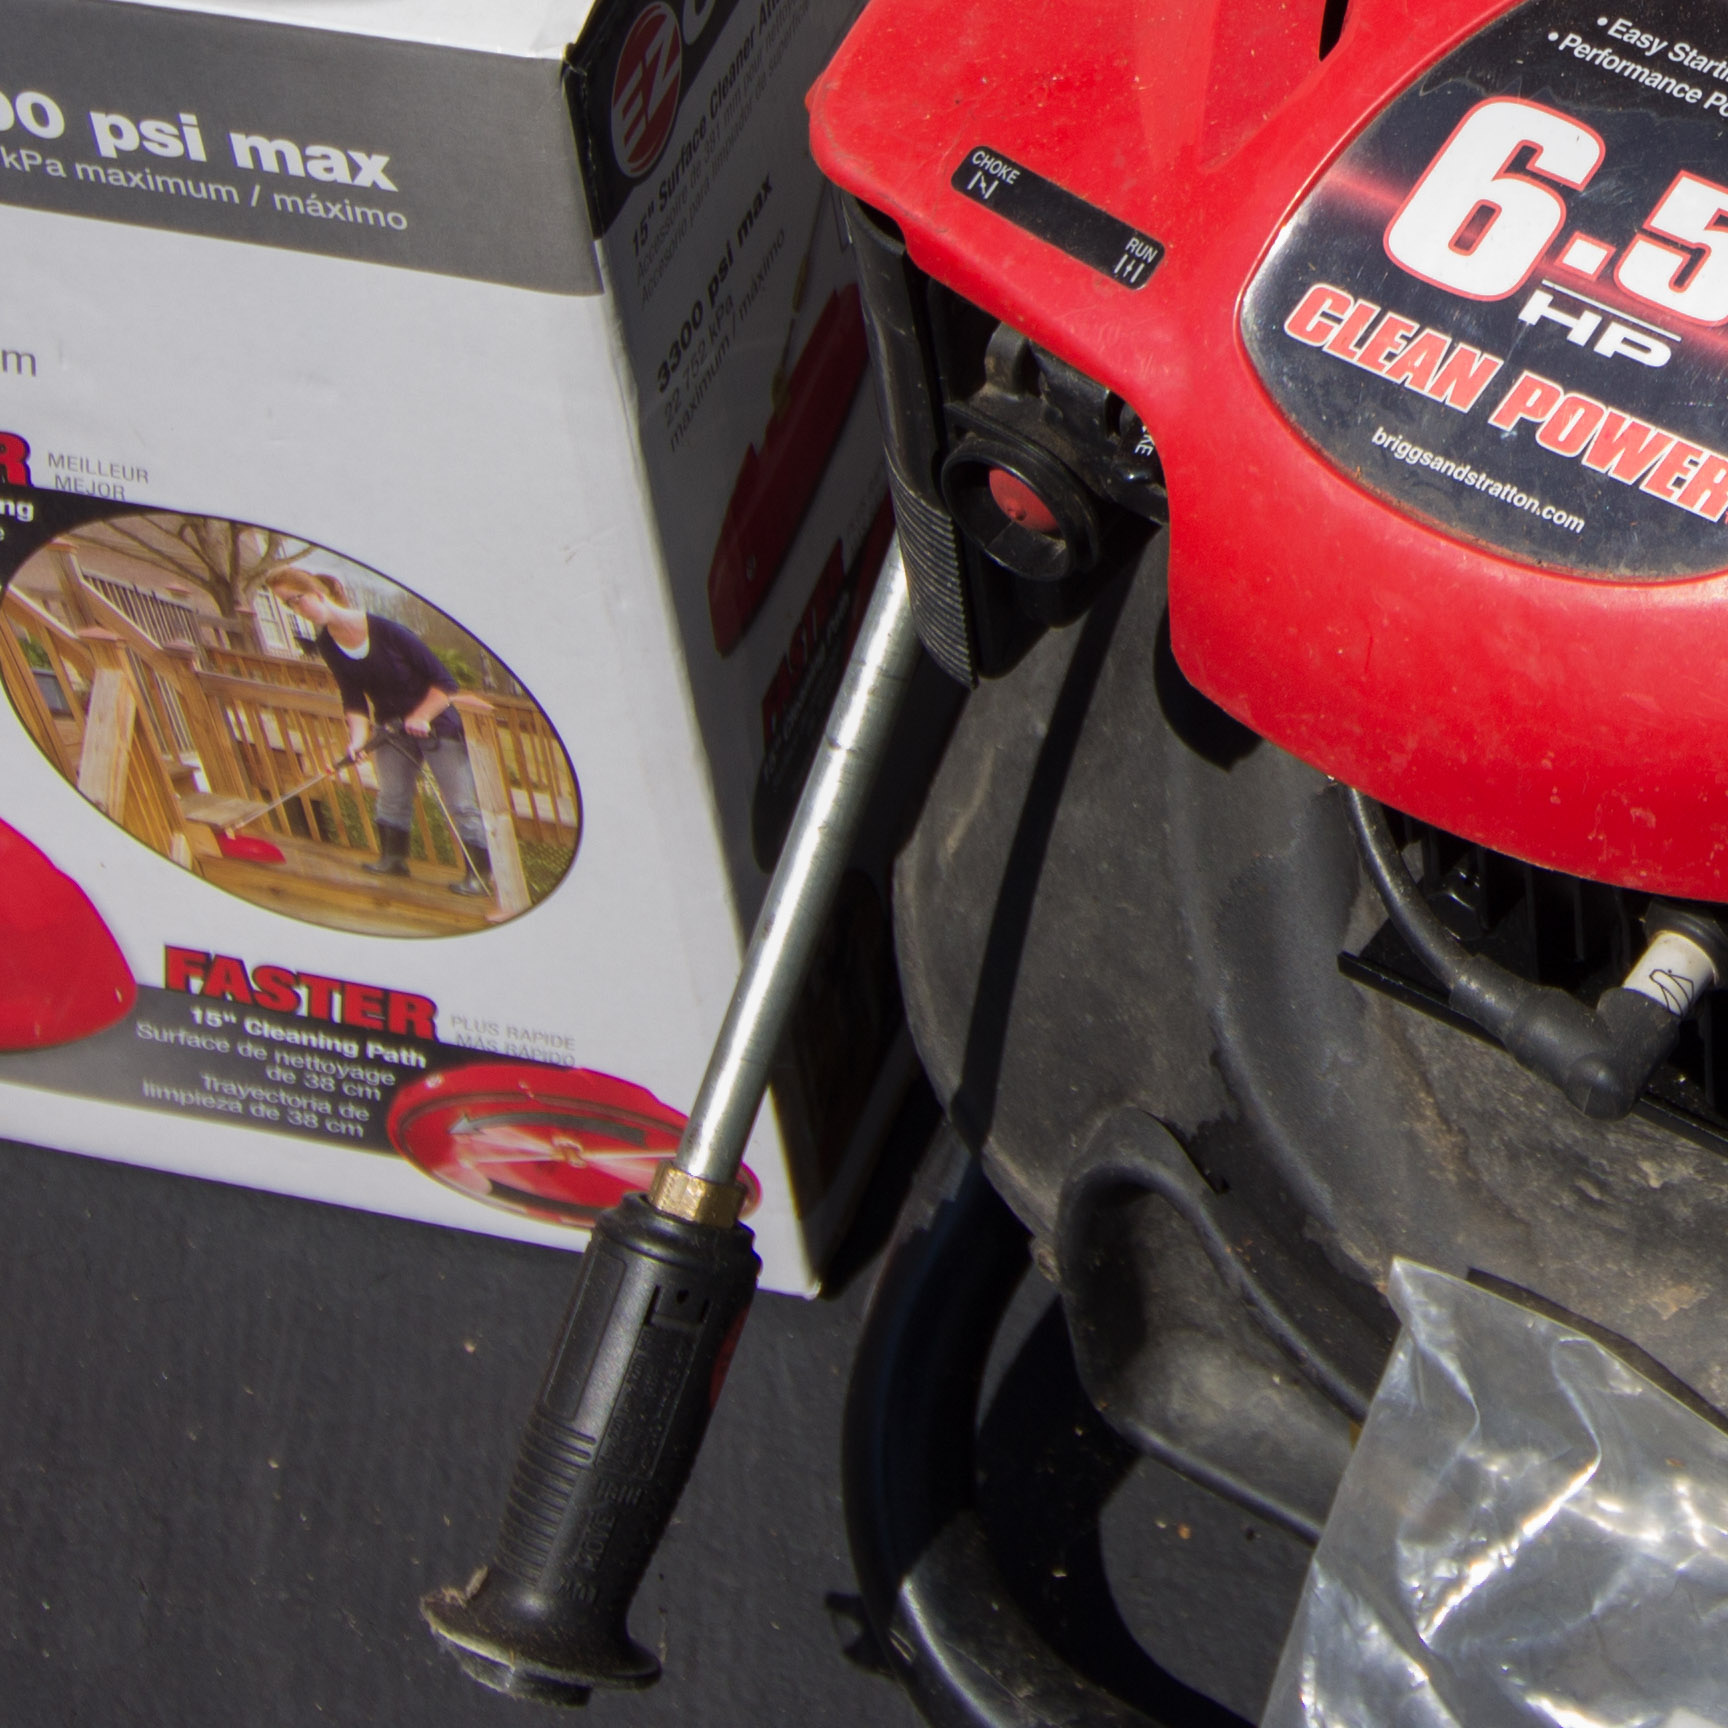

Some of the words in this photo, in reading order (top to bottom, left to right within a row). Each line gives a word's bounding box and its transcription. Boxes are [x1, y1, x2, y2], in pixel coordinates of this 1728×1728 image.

[1558, 32, 1703, 104] Performance
[1607, 18, 1668, 57] Easy
[89, 110, 207, 162] psi
[228, 132, 399, 192] max
[658, 115, 707, 213] Surface
[709, 26, 756, 119] Cleaner
[0, 145, 67, 178] kPa
[74, 161, 240, 204] maximum
[250, 183, 261, 207] /
[273, 192, 408, 230] máximo
[971, 150, 1020, 185] CHOKE
[656, 299, 705, 394] 3300
[708, 238, 735, 310] psi
[736, 171, 774, 249] max
[1125, 237, 1158, 264] RUN
[1283, 282, 1504, 415] CLEAN
[1517, 289, 1676, 369] HP
[670, 334, 731, 454] maximum
[48, 452, 150, 484] MEILLEUR
[54, 473, 126, 501] MEJOR
[1371, 426, 1585, 534] briggsandstratton.com
[163, 943, 438, 1041] FASTER
[135, 1020, 231, 1054] Surface
[237, 1040, 268, 1062] de
[272, 1048, 397, 1087] nettoyage
[191, 1003, 237, 1029] 15"
[243, 1015, 360, 1060] Cleaning
[365, 1039, 427, 1069] Path
[451, 1014, 499, 1036] PLUS
[506, 1025, 576, 1051] RAPIDE
[142, 1078, 244, 1115] limpieza
[249, 1101, 280, 1122] de
[286, 1107, 319, 1129] 38
[325, 1118, 365, 1139] cm
[201, 1072, 332, 1117] Trayectoria
[338, 1100, 370, 1122] de
[265, 1063, 297, 1085] de
[303, 1070, 336, 1093] 38
[342, 1080, 382, 1102] cm
